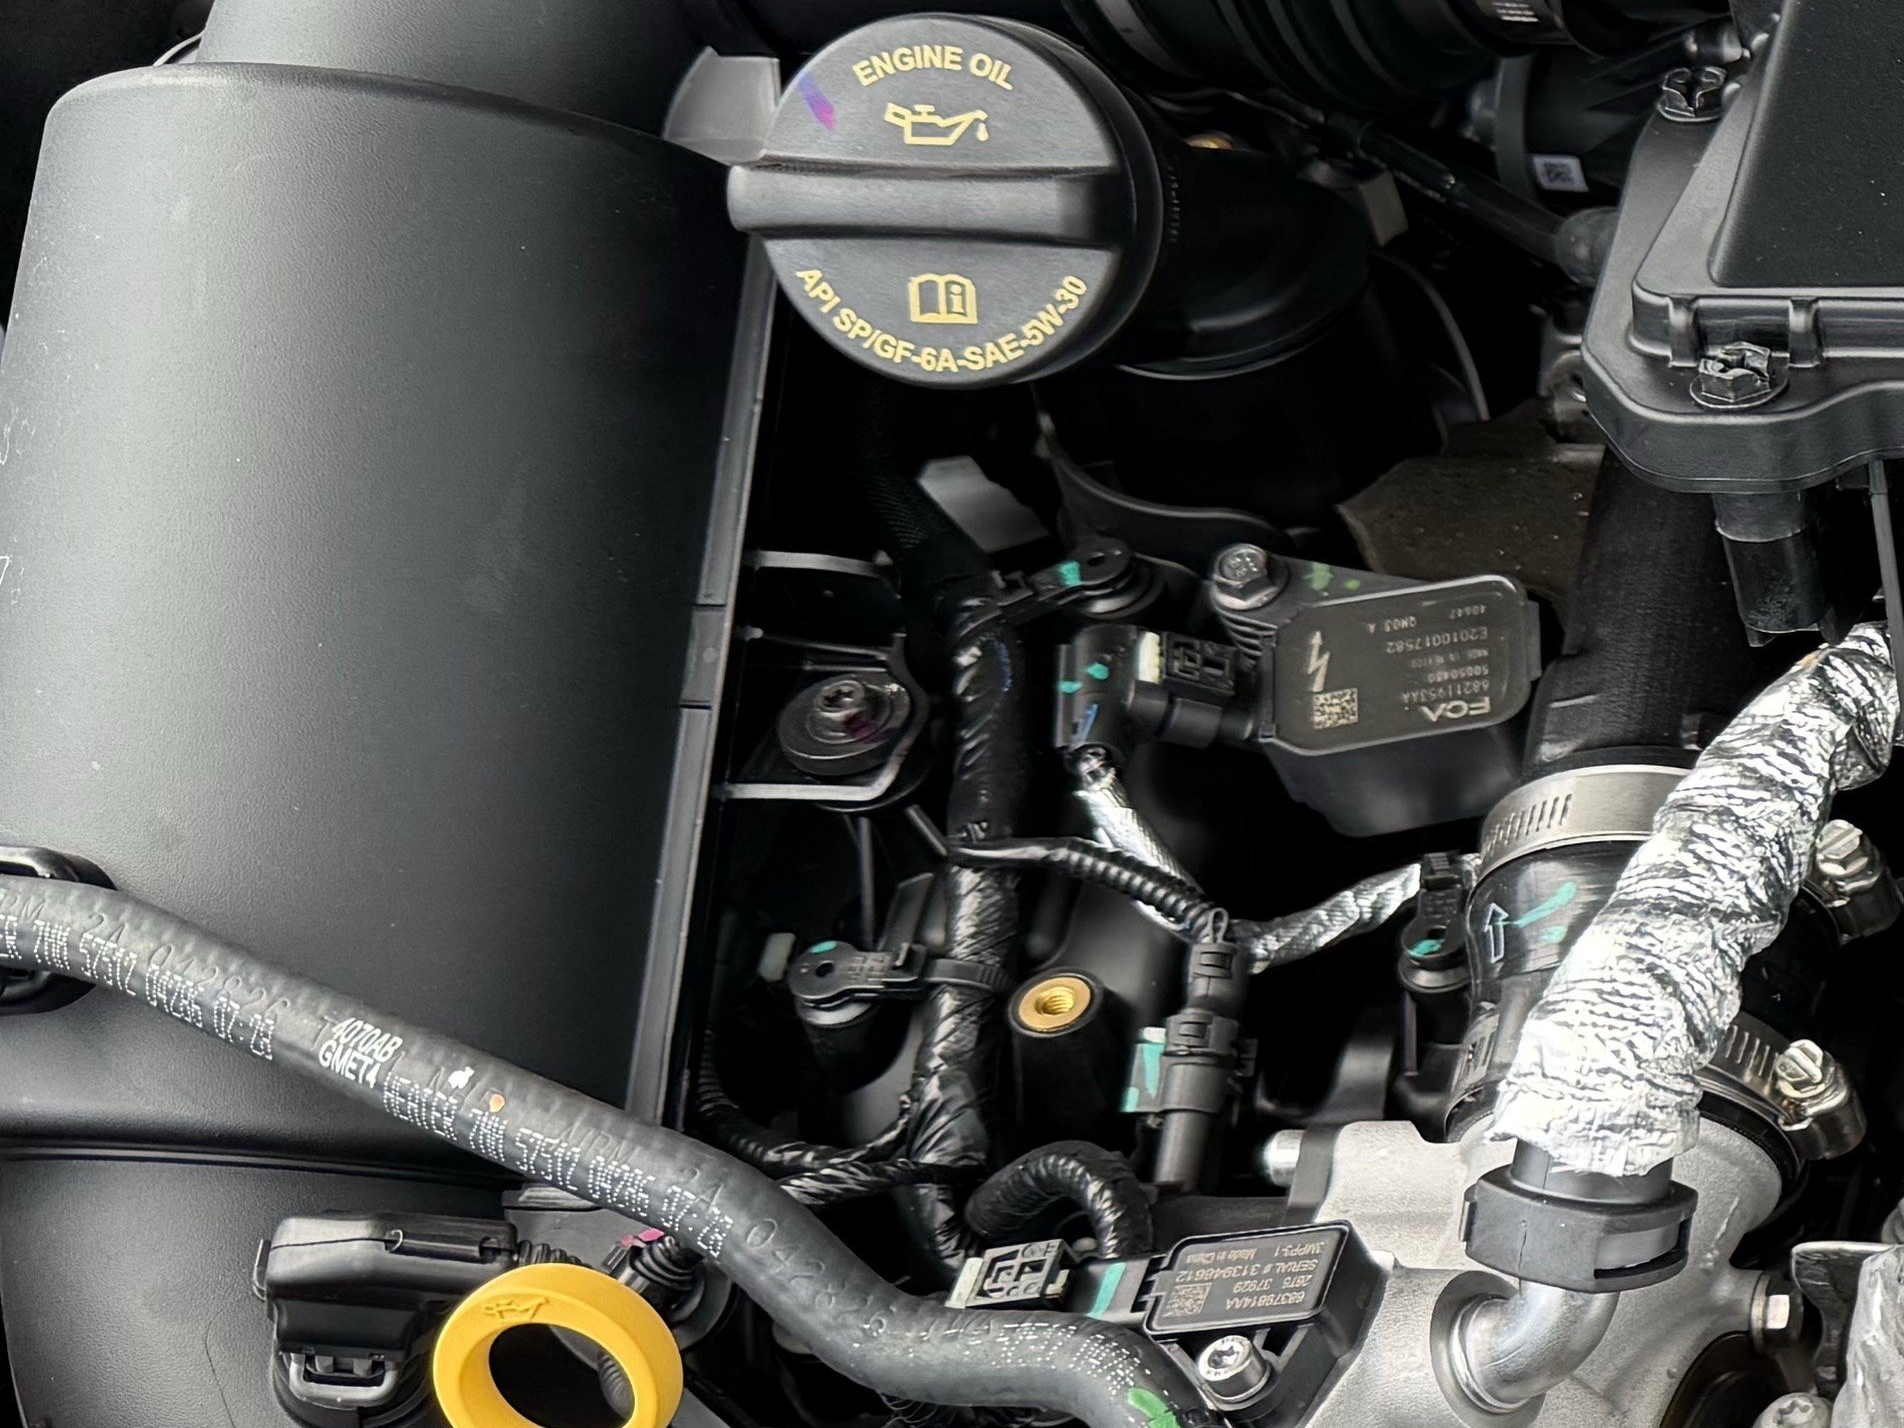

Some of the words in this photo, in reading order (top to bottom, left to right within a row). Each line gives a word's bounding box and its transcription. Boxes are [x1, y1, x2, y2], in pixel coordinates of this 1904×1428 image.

[852, 44, 963, 87] ENGINE
[969, 53, 1014, 91] OIL
[796, 268, 840, 314] API
[1419, 696, 1490, 721] FCA
[1276, 1259, 1318, 1274] SERIAL
